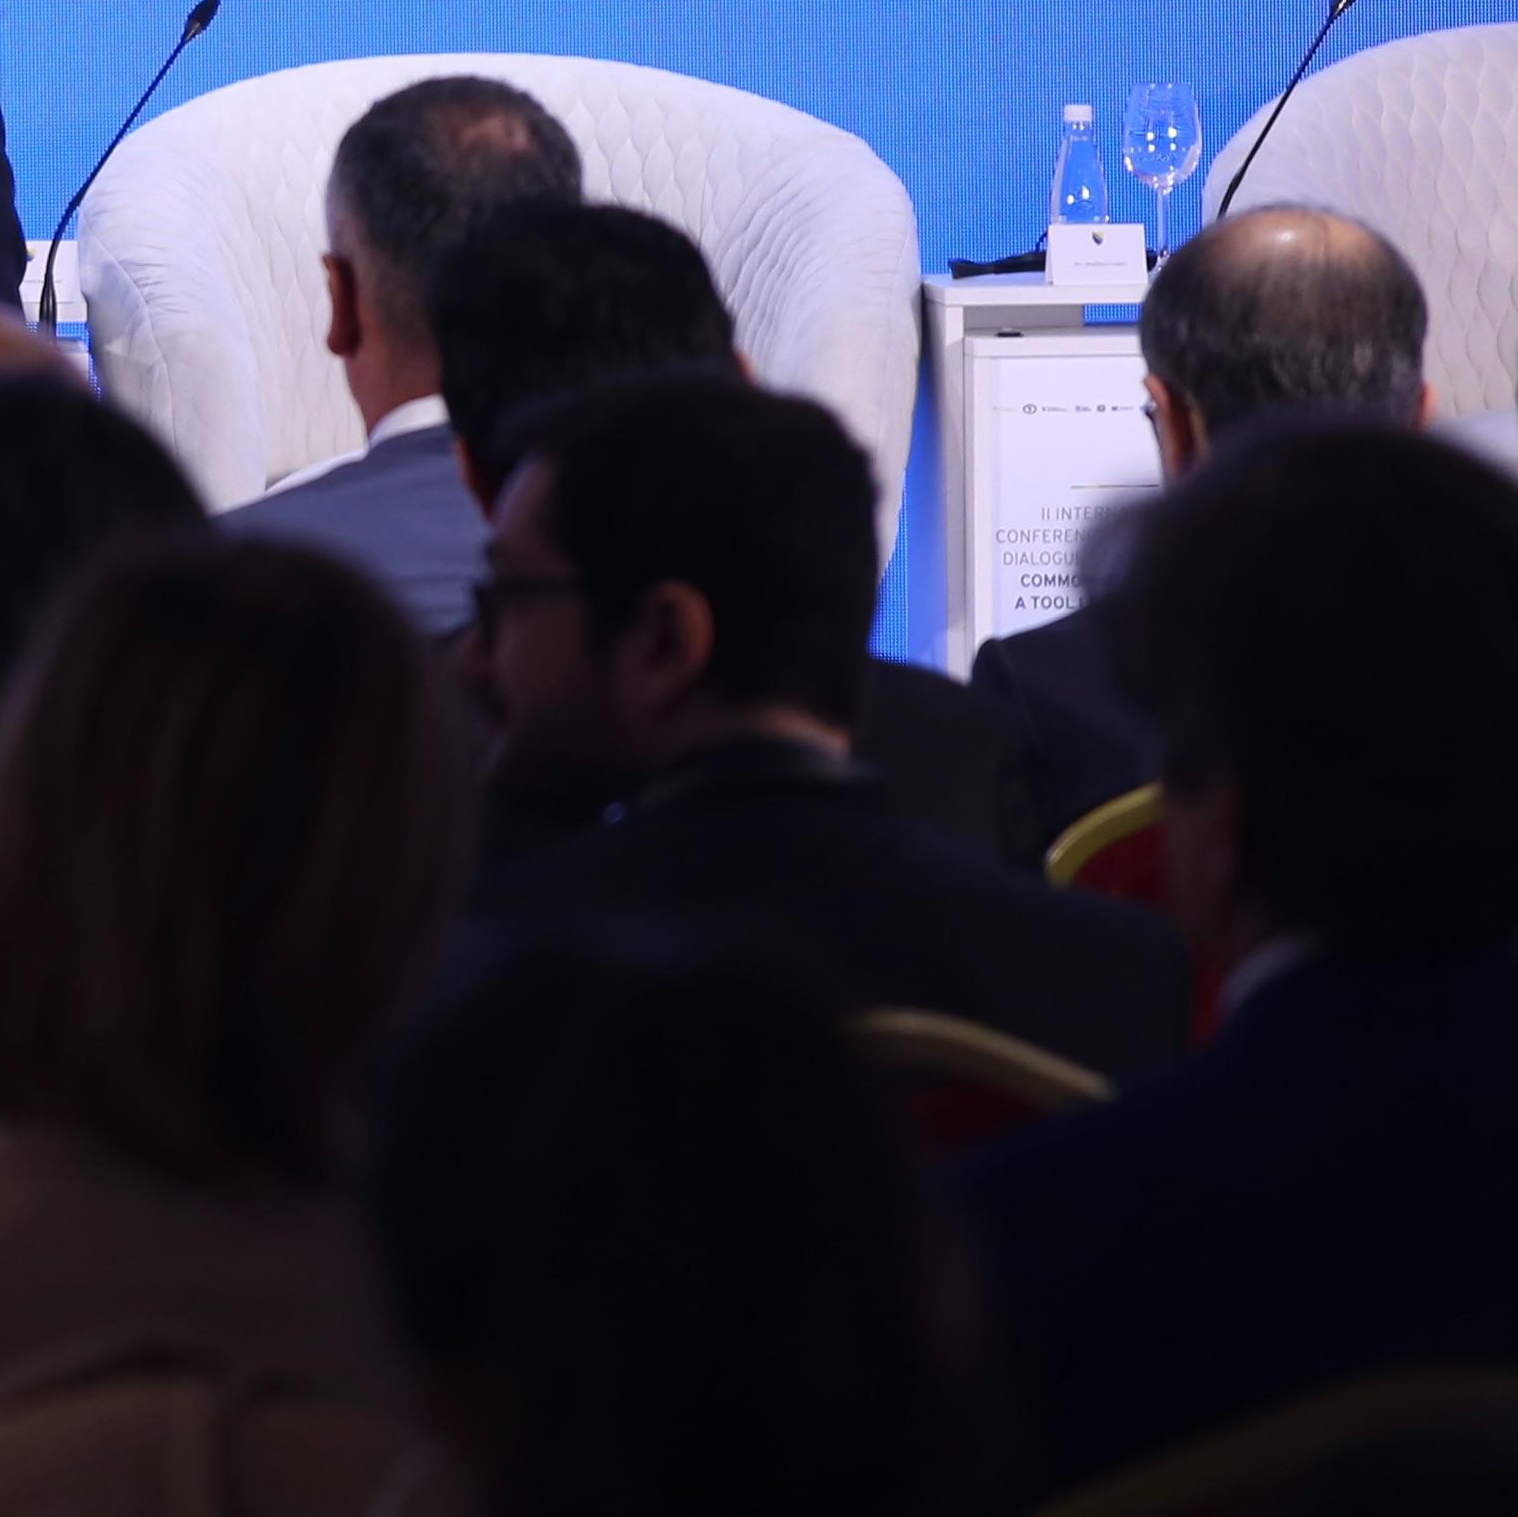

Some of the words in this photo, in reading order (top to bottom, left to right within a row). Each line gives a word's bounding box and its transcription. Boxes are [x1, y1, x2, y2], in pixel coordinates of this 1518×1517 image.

[996, 528, 1086, 543] CONFEREN
[1003, 551, 1080, 566] DIALOGU
[1020, 573, 1080, 588] COMMO
[1014, 596, 1026, 610] A
[1031, 595, 1074, 610] TOOL
